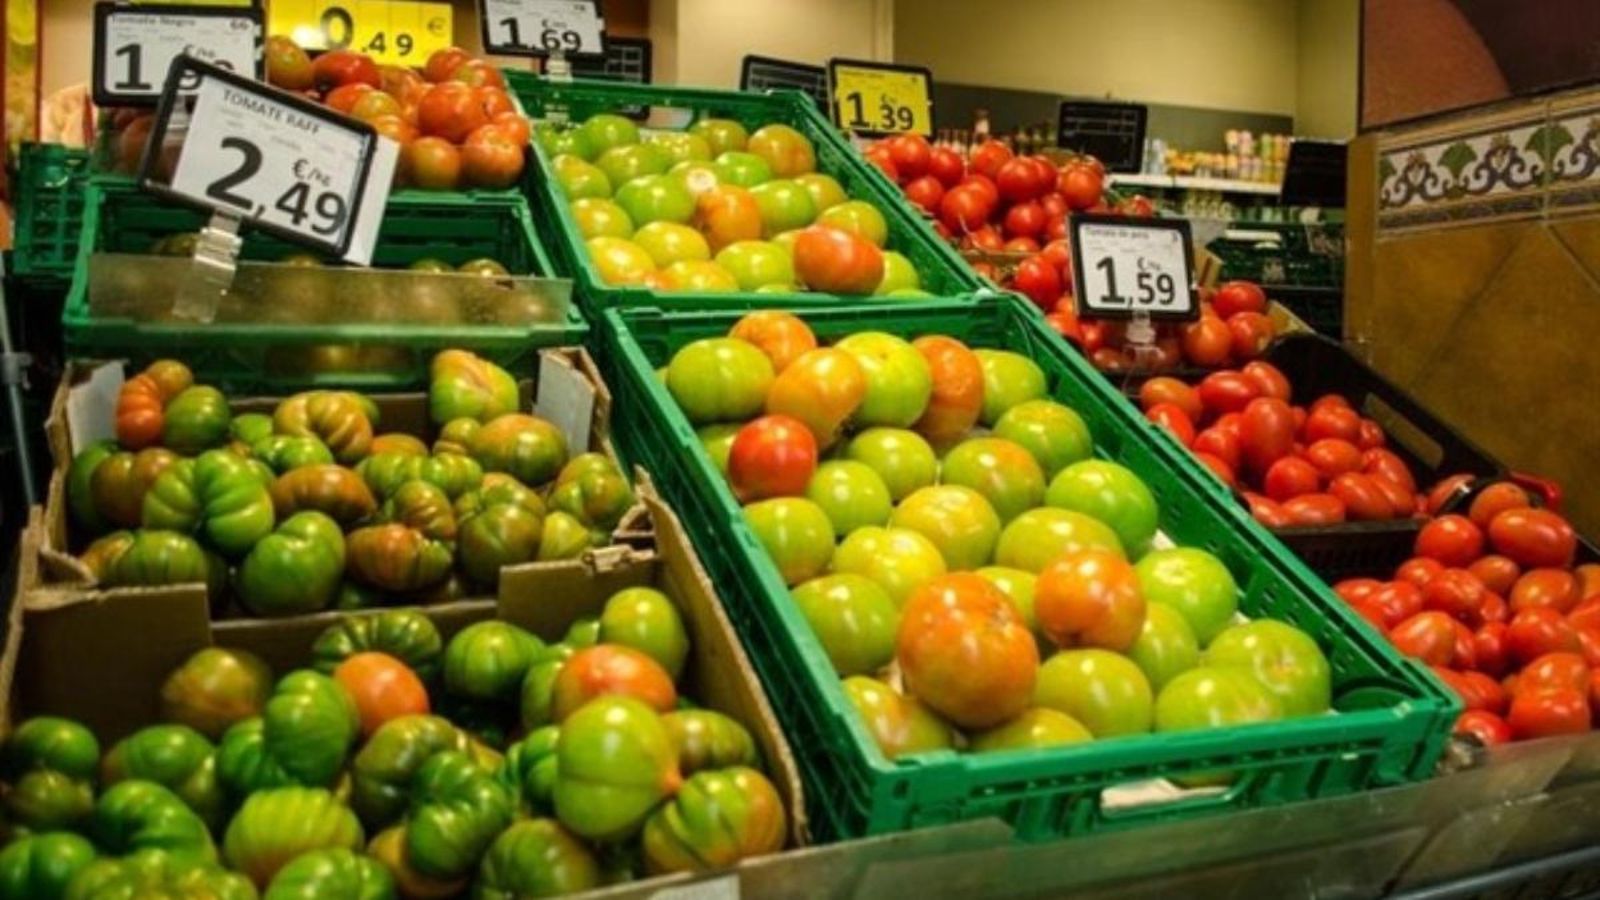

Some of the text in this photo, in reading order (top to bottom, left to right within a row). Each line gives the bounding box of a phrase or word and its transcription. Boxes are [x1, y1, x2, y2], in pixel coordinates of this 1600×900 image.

[224, 88, 281, 120] TOMATE
[205, 137, 348, 236] 2,49
[1096, 256, 1176, 308] 1,59
